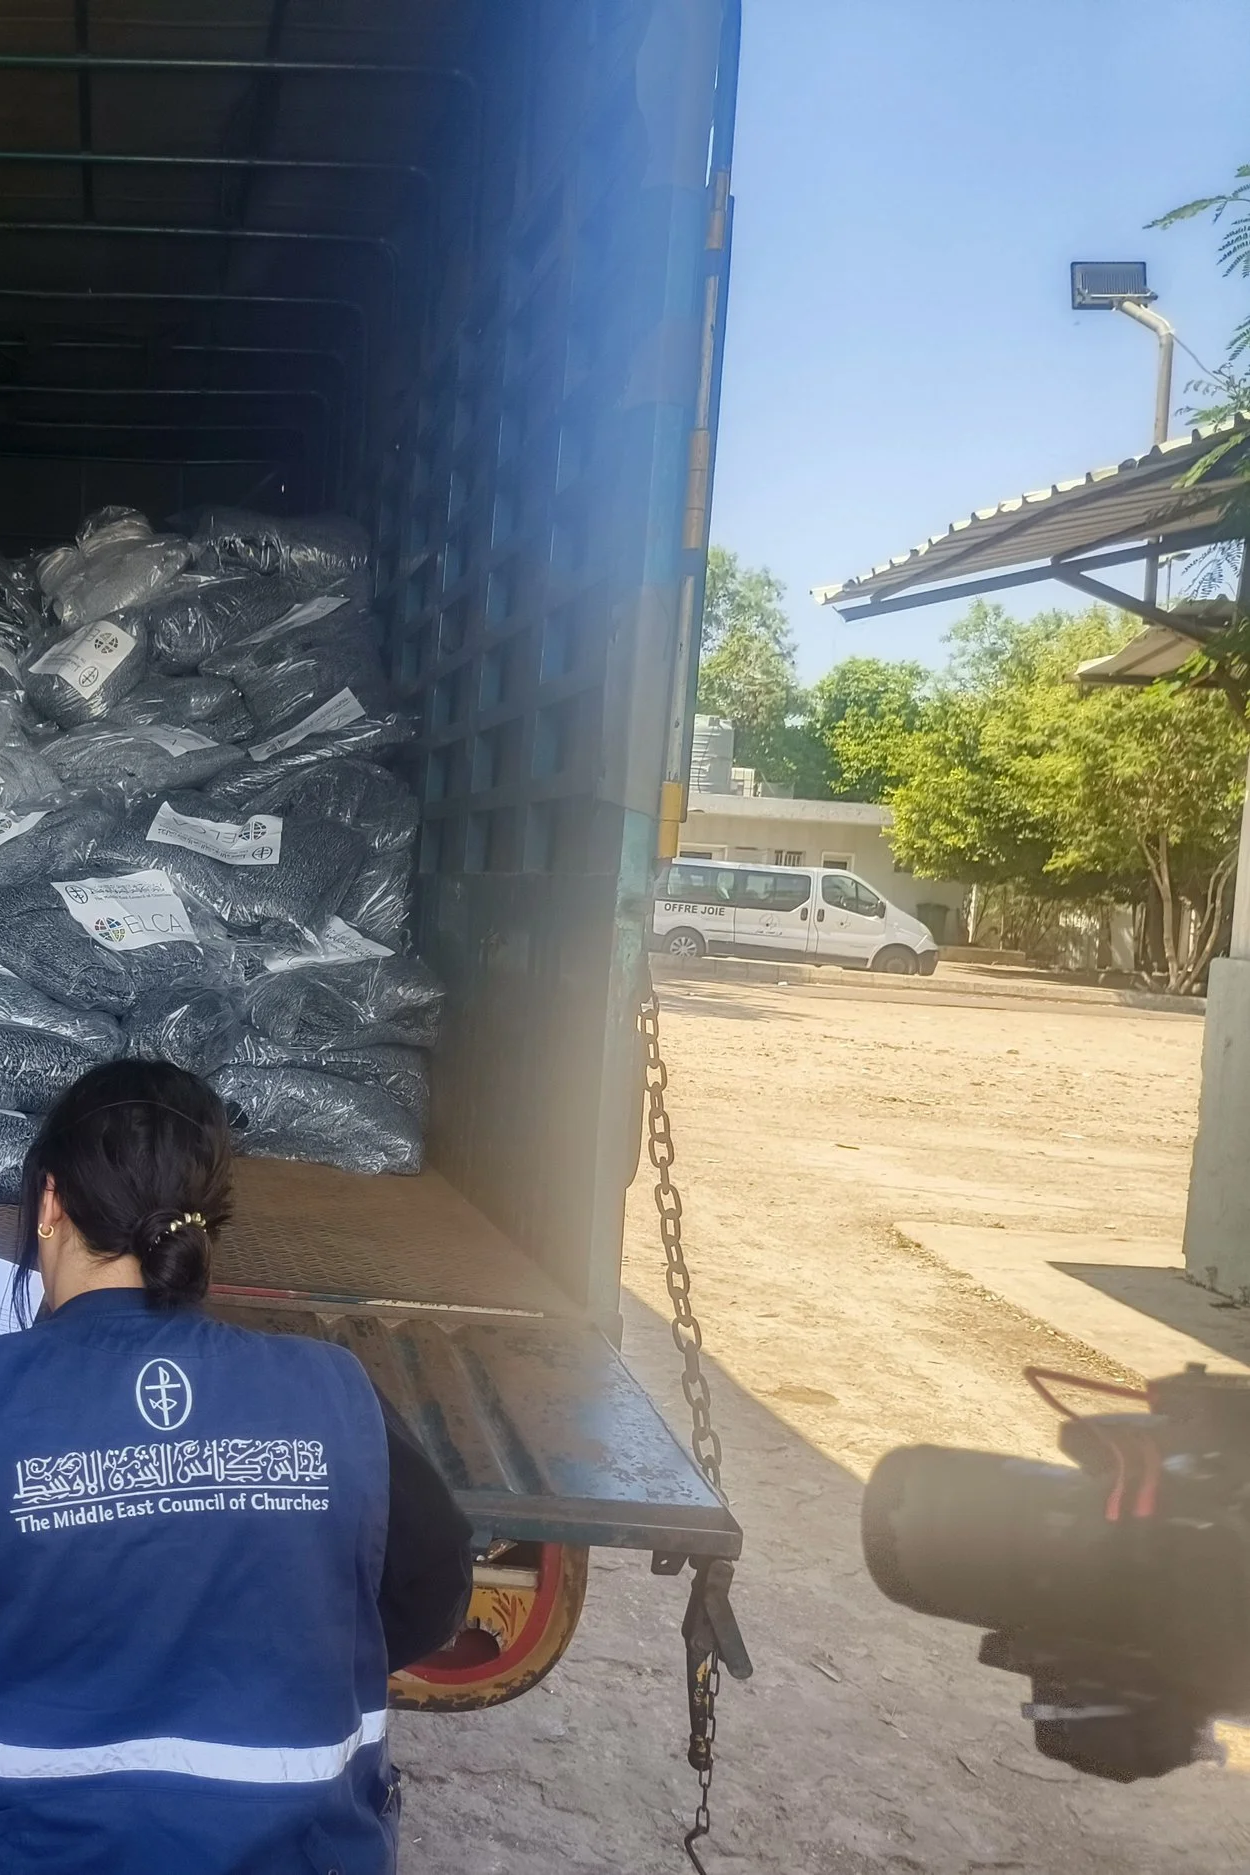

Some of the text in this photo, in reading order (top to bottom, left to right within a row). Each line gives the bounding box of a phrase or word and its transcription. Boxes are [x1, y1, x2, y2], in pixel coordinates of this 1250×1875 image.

[664, 902, 726, 916] OFFRE JOIE
[122, 913, 185, 934] ELCA
[15, 1492, 329, 1533] The Middle East Council of Churches
